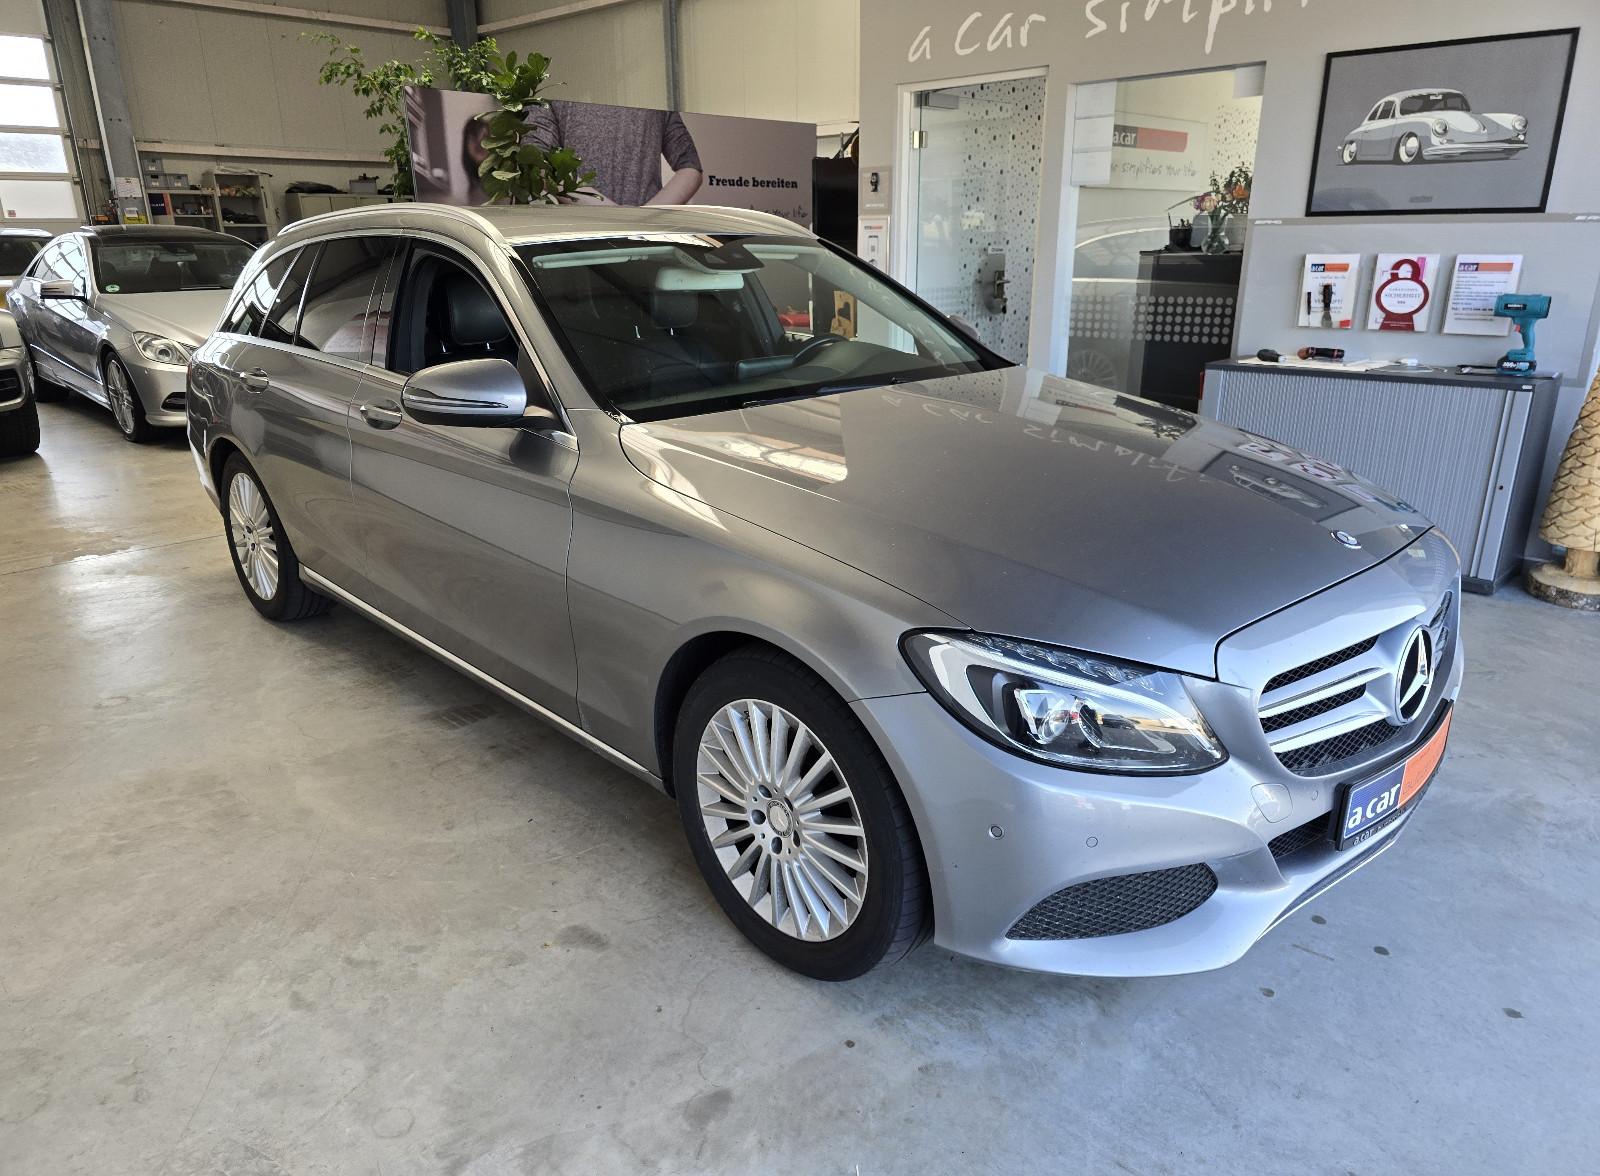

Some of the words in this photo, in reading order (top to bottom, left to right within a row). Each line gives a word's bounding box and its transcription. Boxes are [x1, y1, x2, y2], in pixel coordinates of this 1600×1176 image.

[908, 26, 931, 62] a
[954, 12, 1046, 55] car
[708, 175, 750, 188] Freude
[752, 177, 798, 189] bereiten
